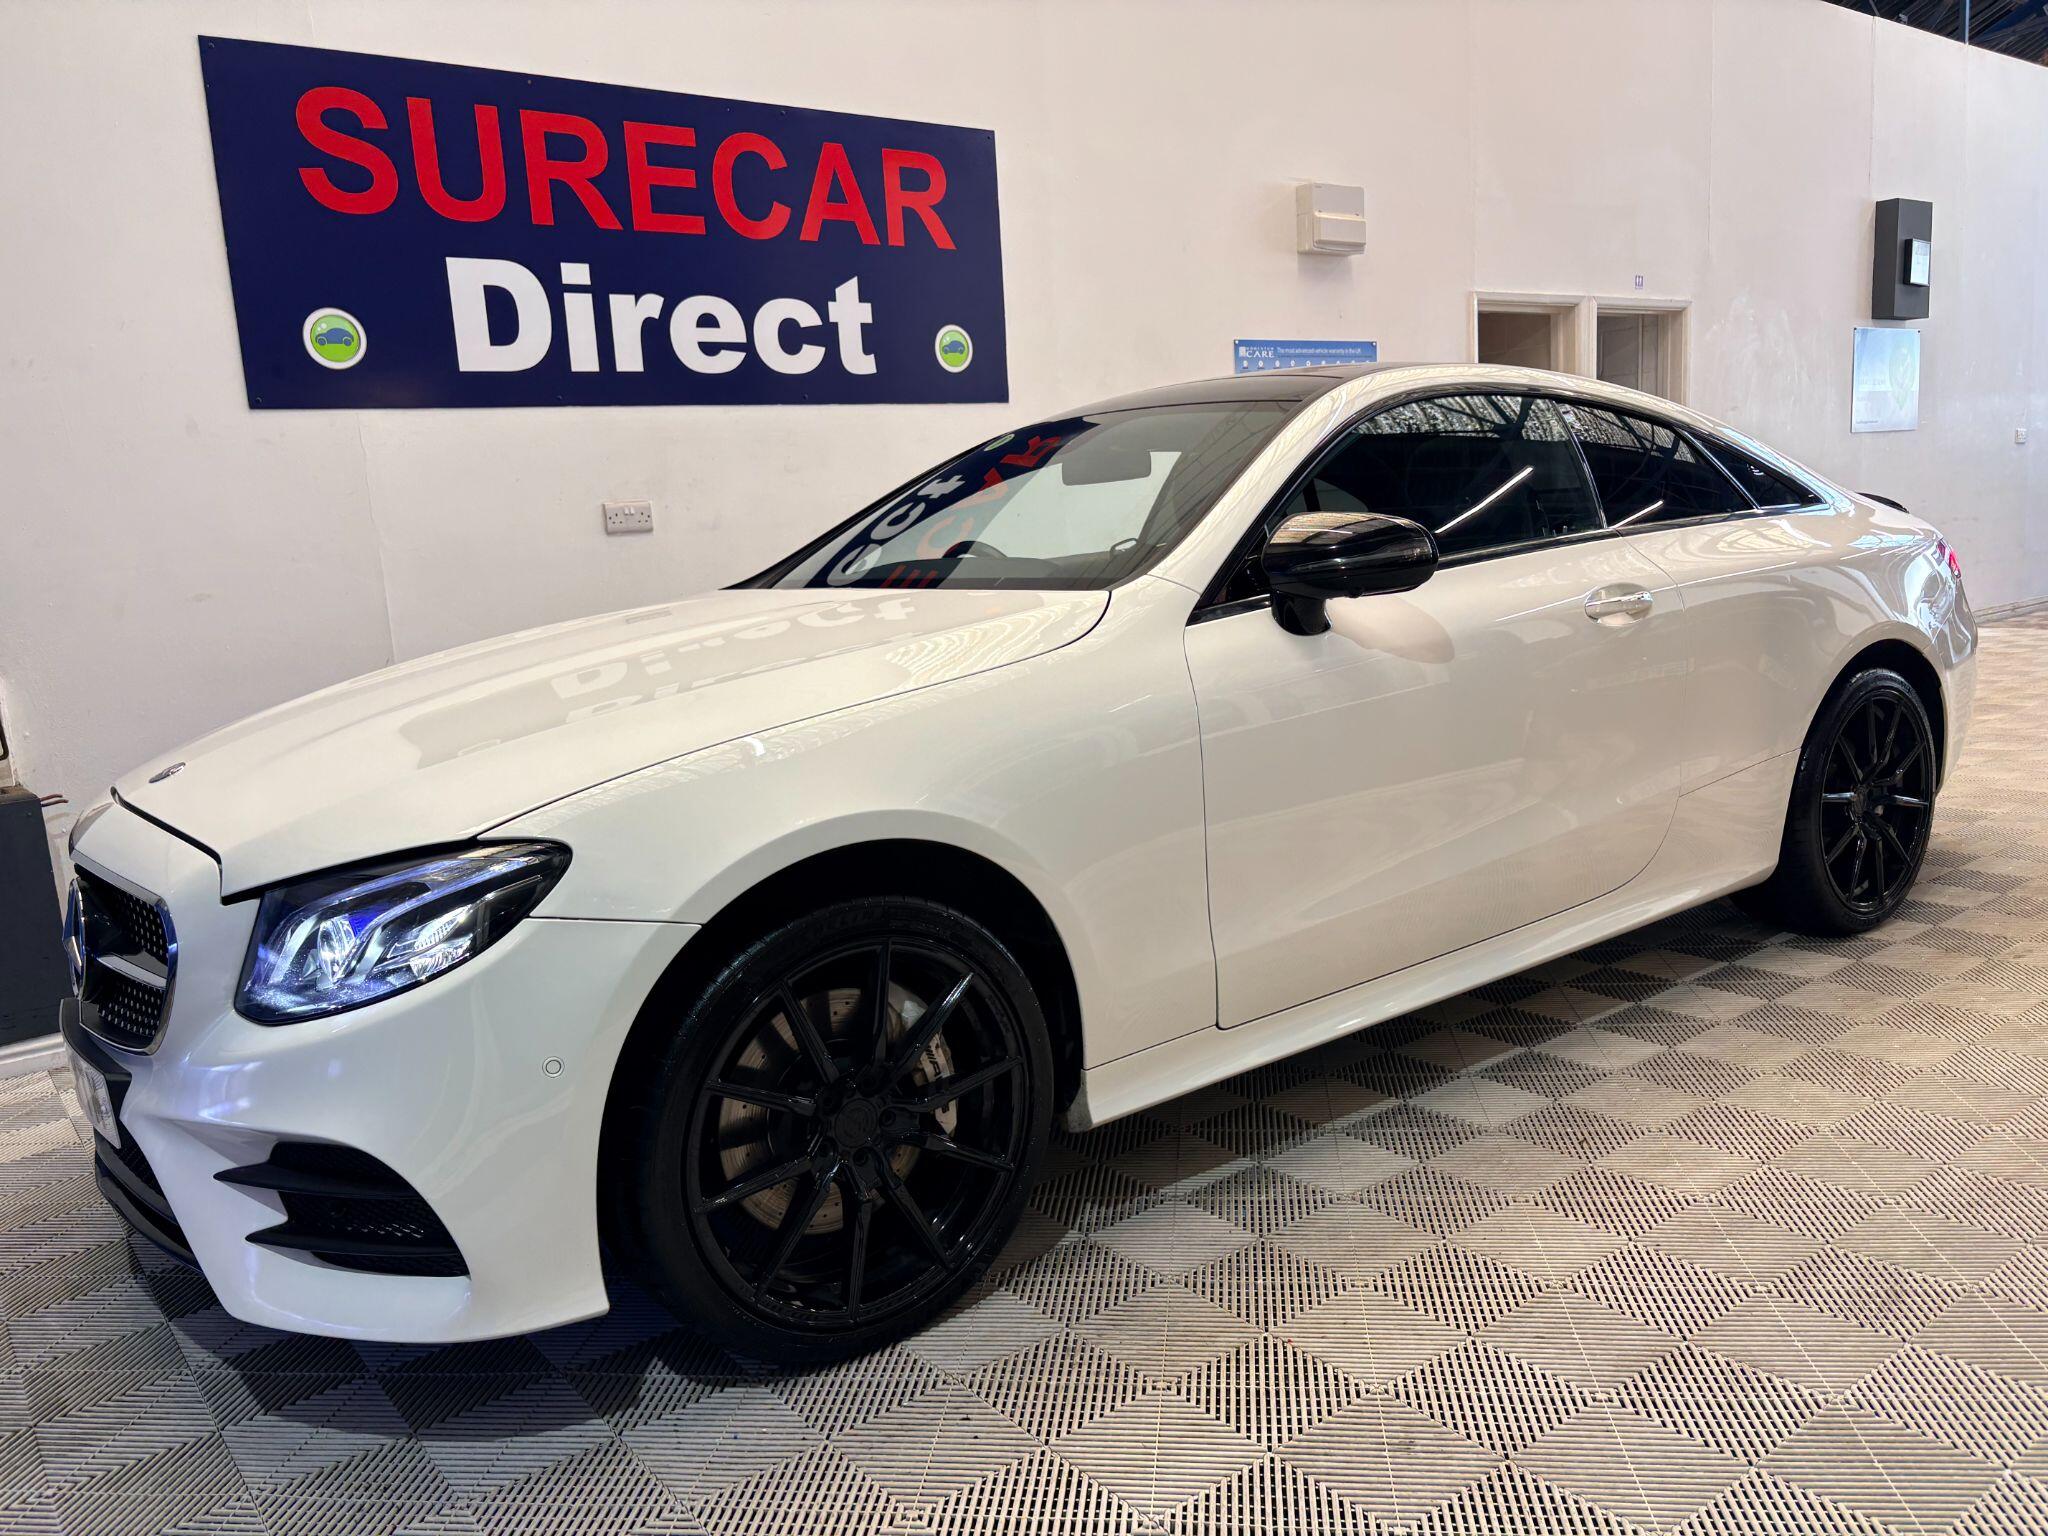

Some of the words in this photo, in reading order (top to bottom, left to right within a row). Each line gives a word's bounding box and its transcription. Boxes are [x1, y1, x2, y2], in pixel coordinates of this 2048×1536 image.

[297, 86, 957, 250] SURECAR
[446, 256, 877, 375] Direct
[1247, 350, 1275, 358] CARE
